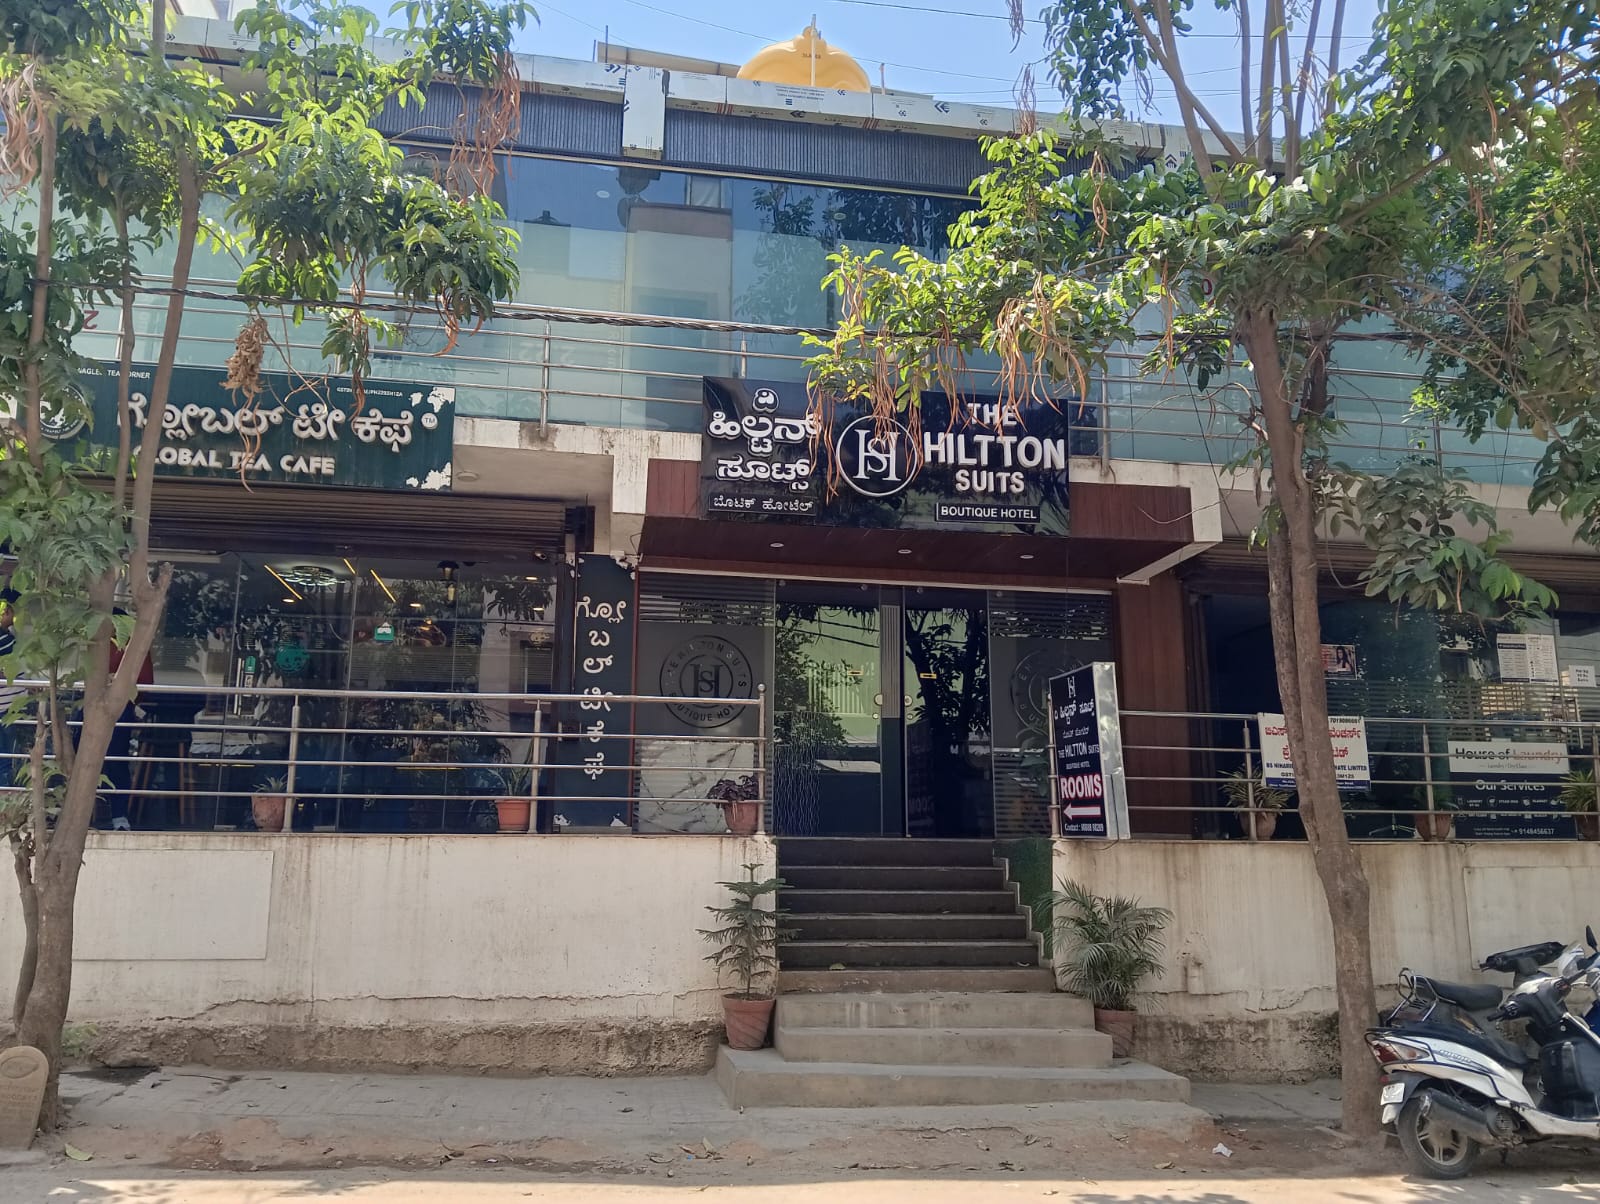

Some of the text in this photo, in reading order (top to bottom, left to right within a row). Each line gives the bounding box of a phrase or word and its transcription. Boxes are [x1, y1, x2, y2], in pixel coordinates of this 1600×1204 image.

[967, 402, 1018, 426] THE
[132, 445, 336, 476] OBAL TEA CAFE
[923, 431, 1066, 470] HILTTON
[955, 469, 1026, 494] SUITS
[940, 505, 1038, 520] BOUTIQUE HOTEL
[1455, 747, 1563, 764] House of Laundry
[1060, 773, 1103, 799] ROOMS
[1474, 779, 1545, 792] Our Services
